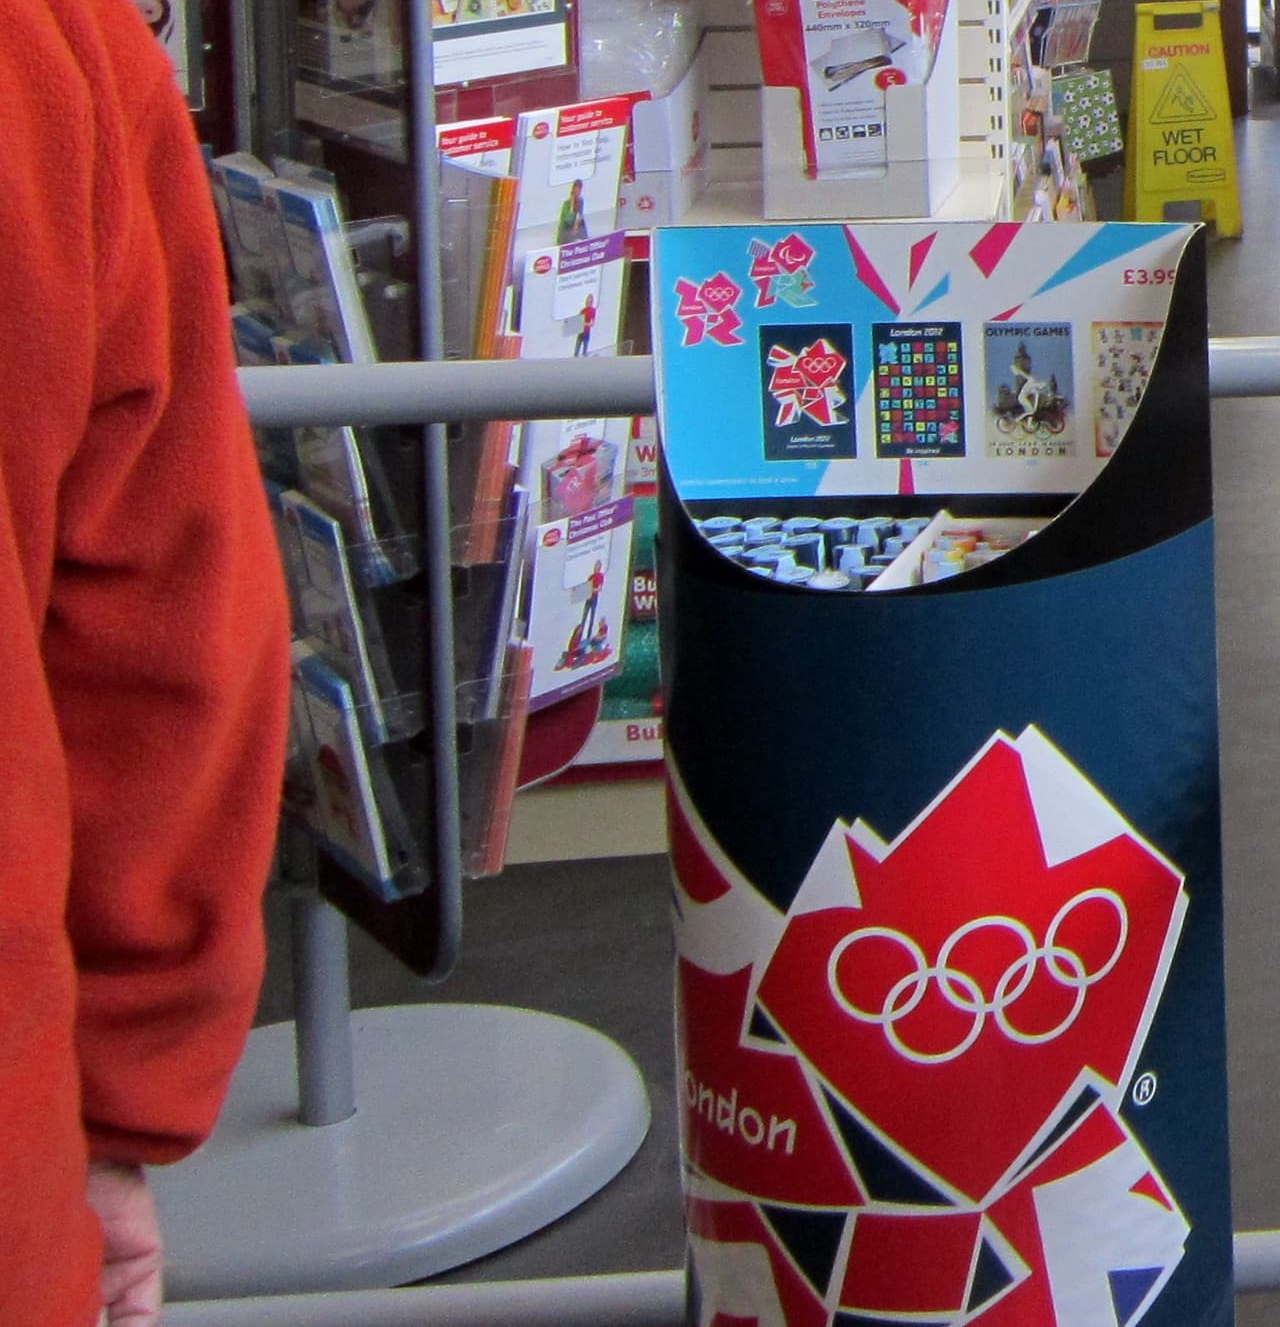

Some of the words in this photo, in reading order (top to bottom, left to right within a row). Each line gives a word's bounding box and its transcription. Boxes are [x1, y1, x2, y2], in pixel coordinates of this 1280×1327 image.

[816, 0, 866, 10] Polythene
[854, 19, 891, 29] 320mm
[1148, 43, 1210, 58] CAUTION
[886, 75, 896, 86] 5
[1162, 128, 1205, 145] WET
[1153, 146, 1217, 166] FLOOR
[1121, 268, 1176, 287] £3.99
[889, 327, 922, 338] London
[923, 327, 944, 337] 2012
[984, 327, 1032, 338] OLYMPIC
[1033, 326, 1071, 337] GAMES
[995, 447, 1068, 457] LONDON
[686, 1068, 797, 1156] ondon
